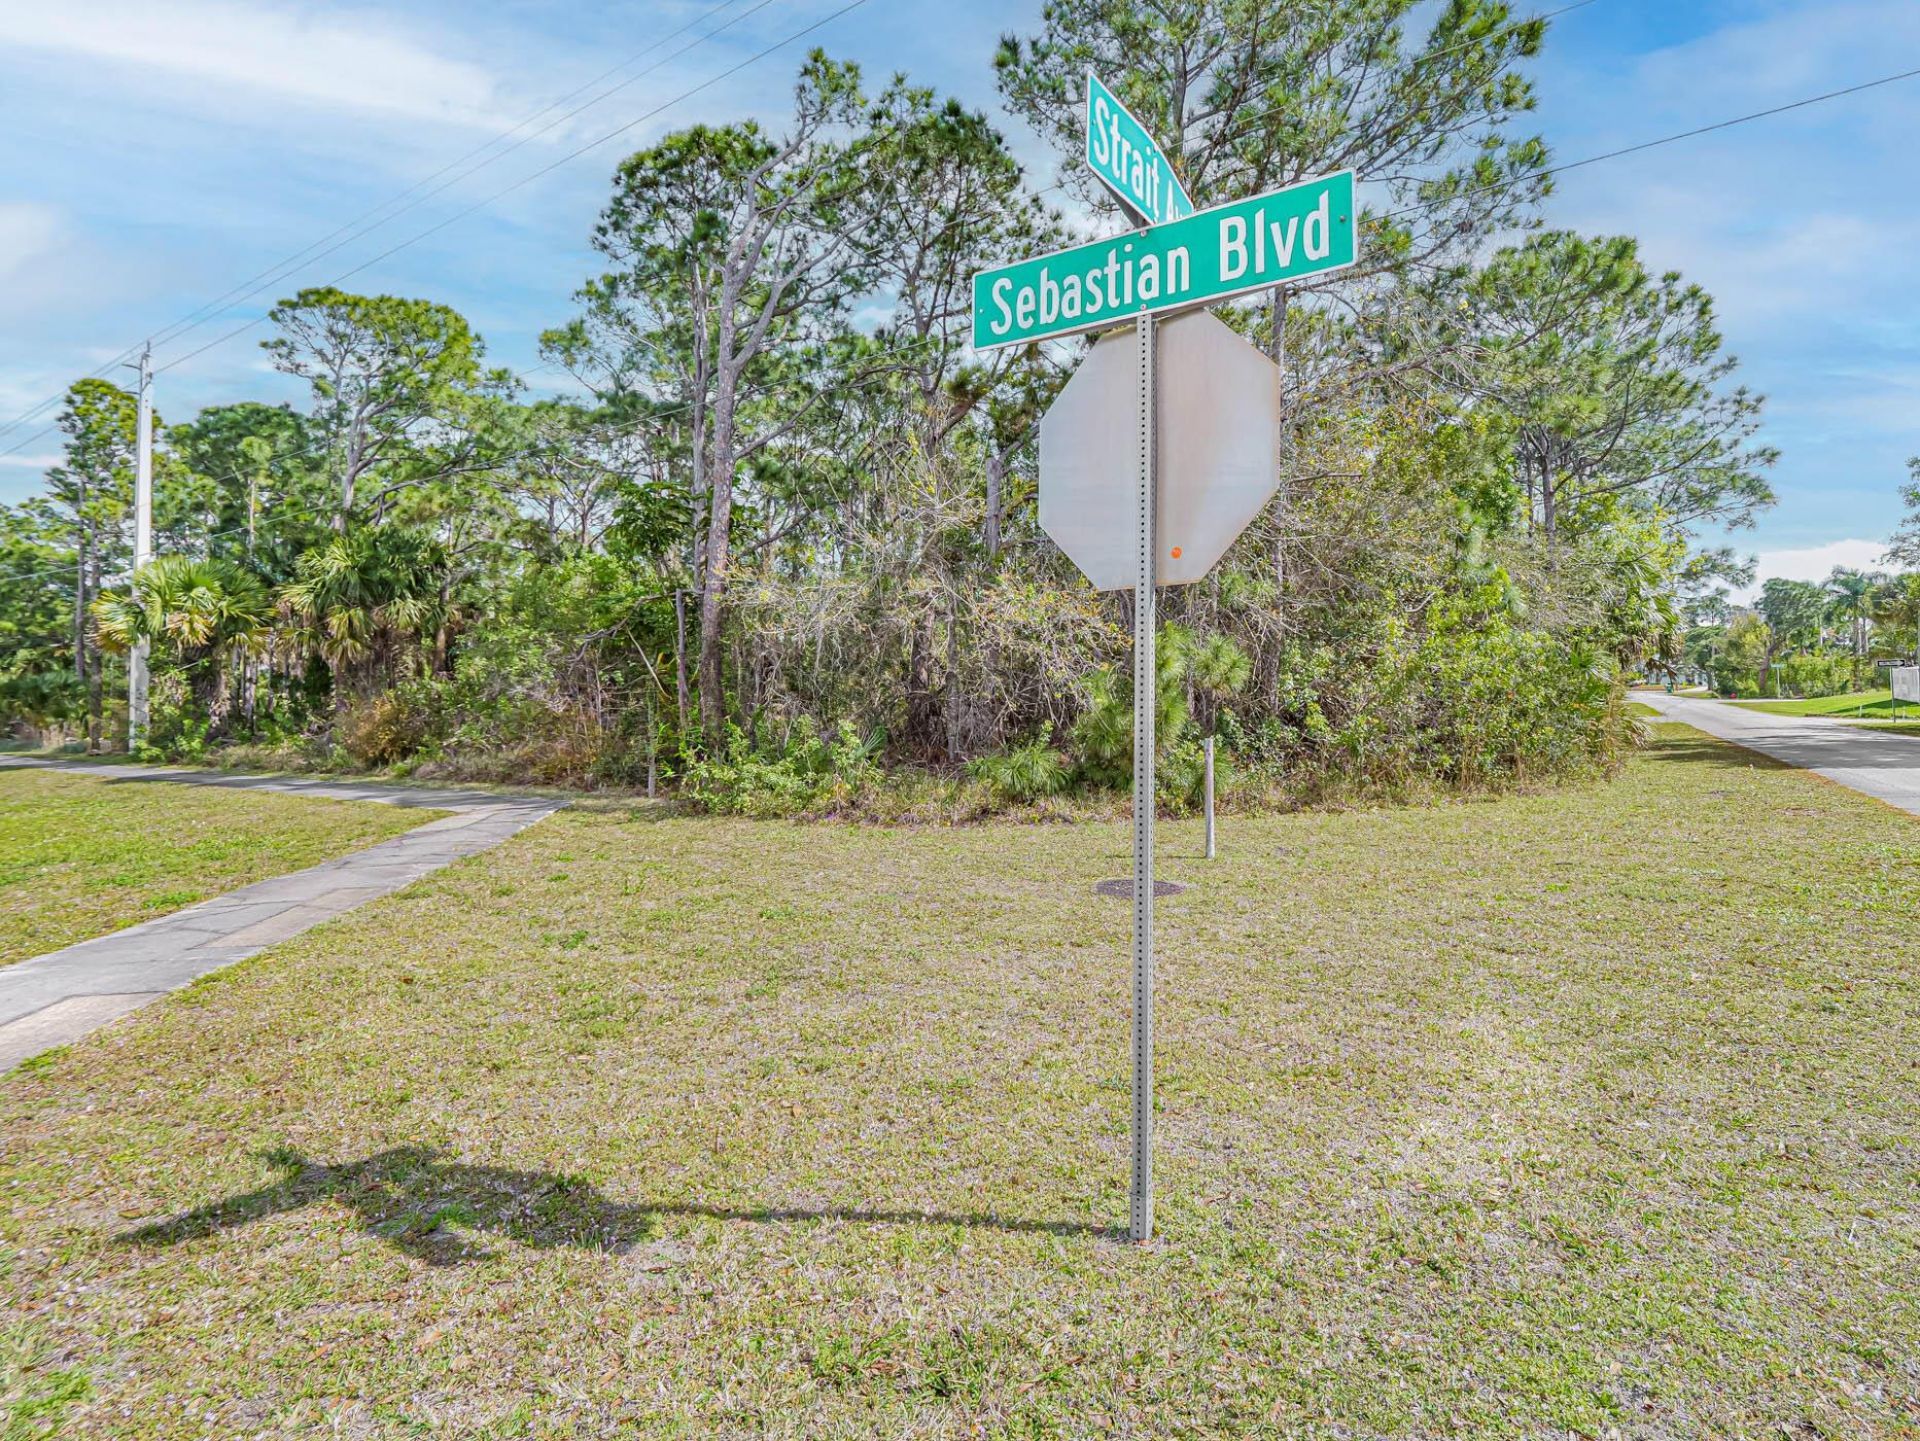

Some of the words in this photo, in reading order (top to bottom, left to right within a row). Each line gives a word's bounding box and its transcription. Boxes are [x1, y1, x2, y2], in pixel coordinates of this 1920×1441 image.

[1094, 96, 1160, 219] Strait
[990, 243, 1191, 335] Sebastian
[1219, 189, 1330, 282] Blvd
